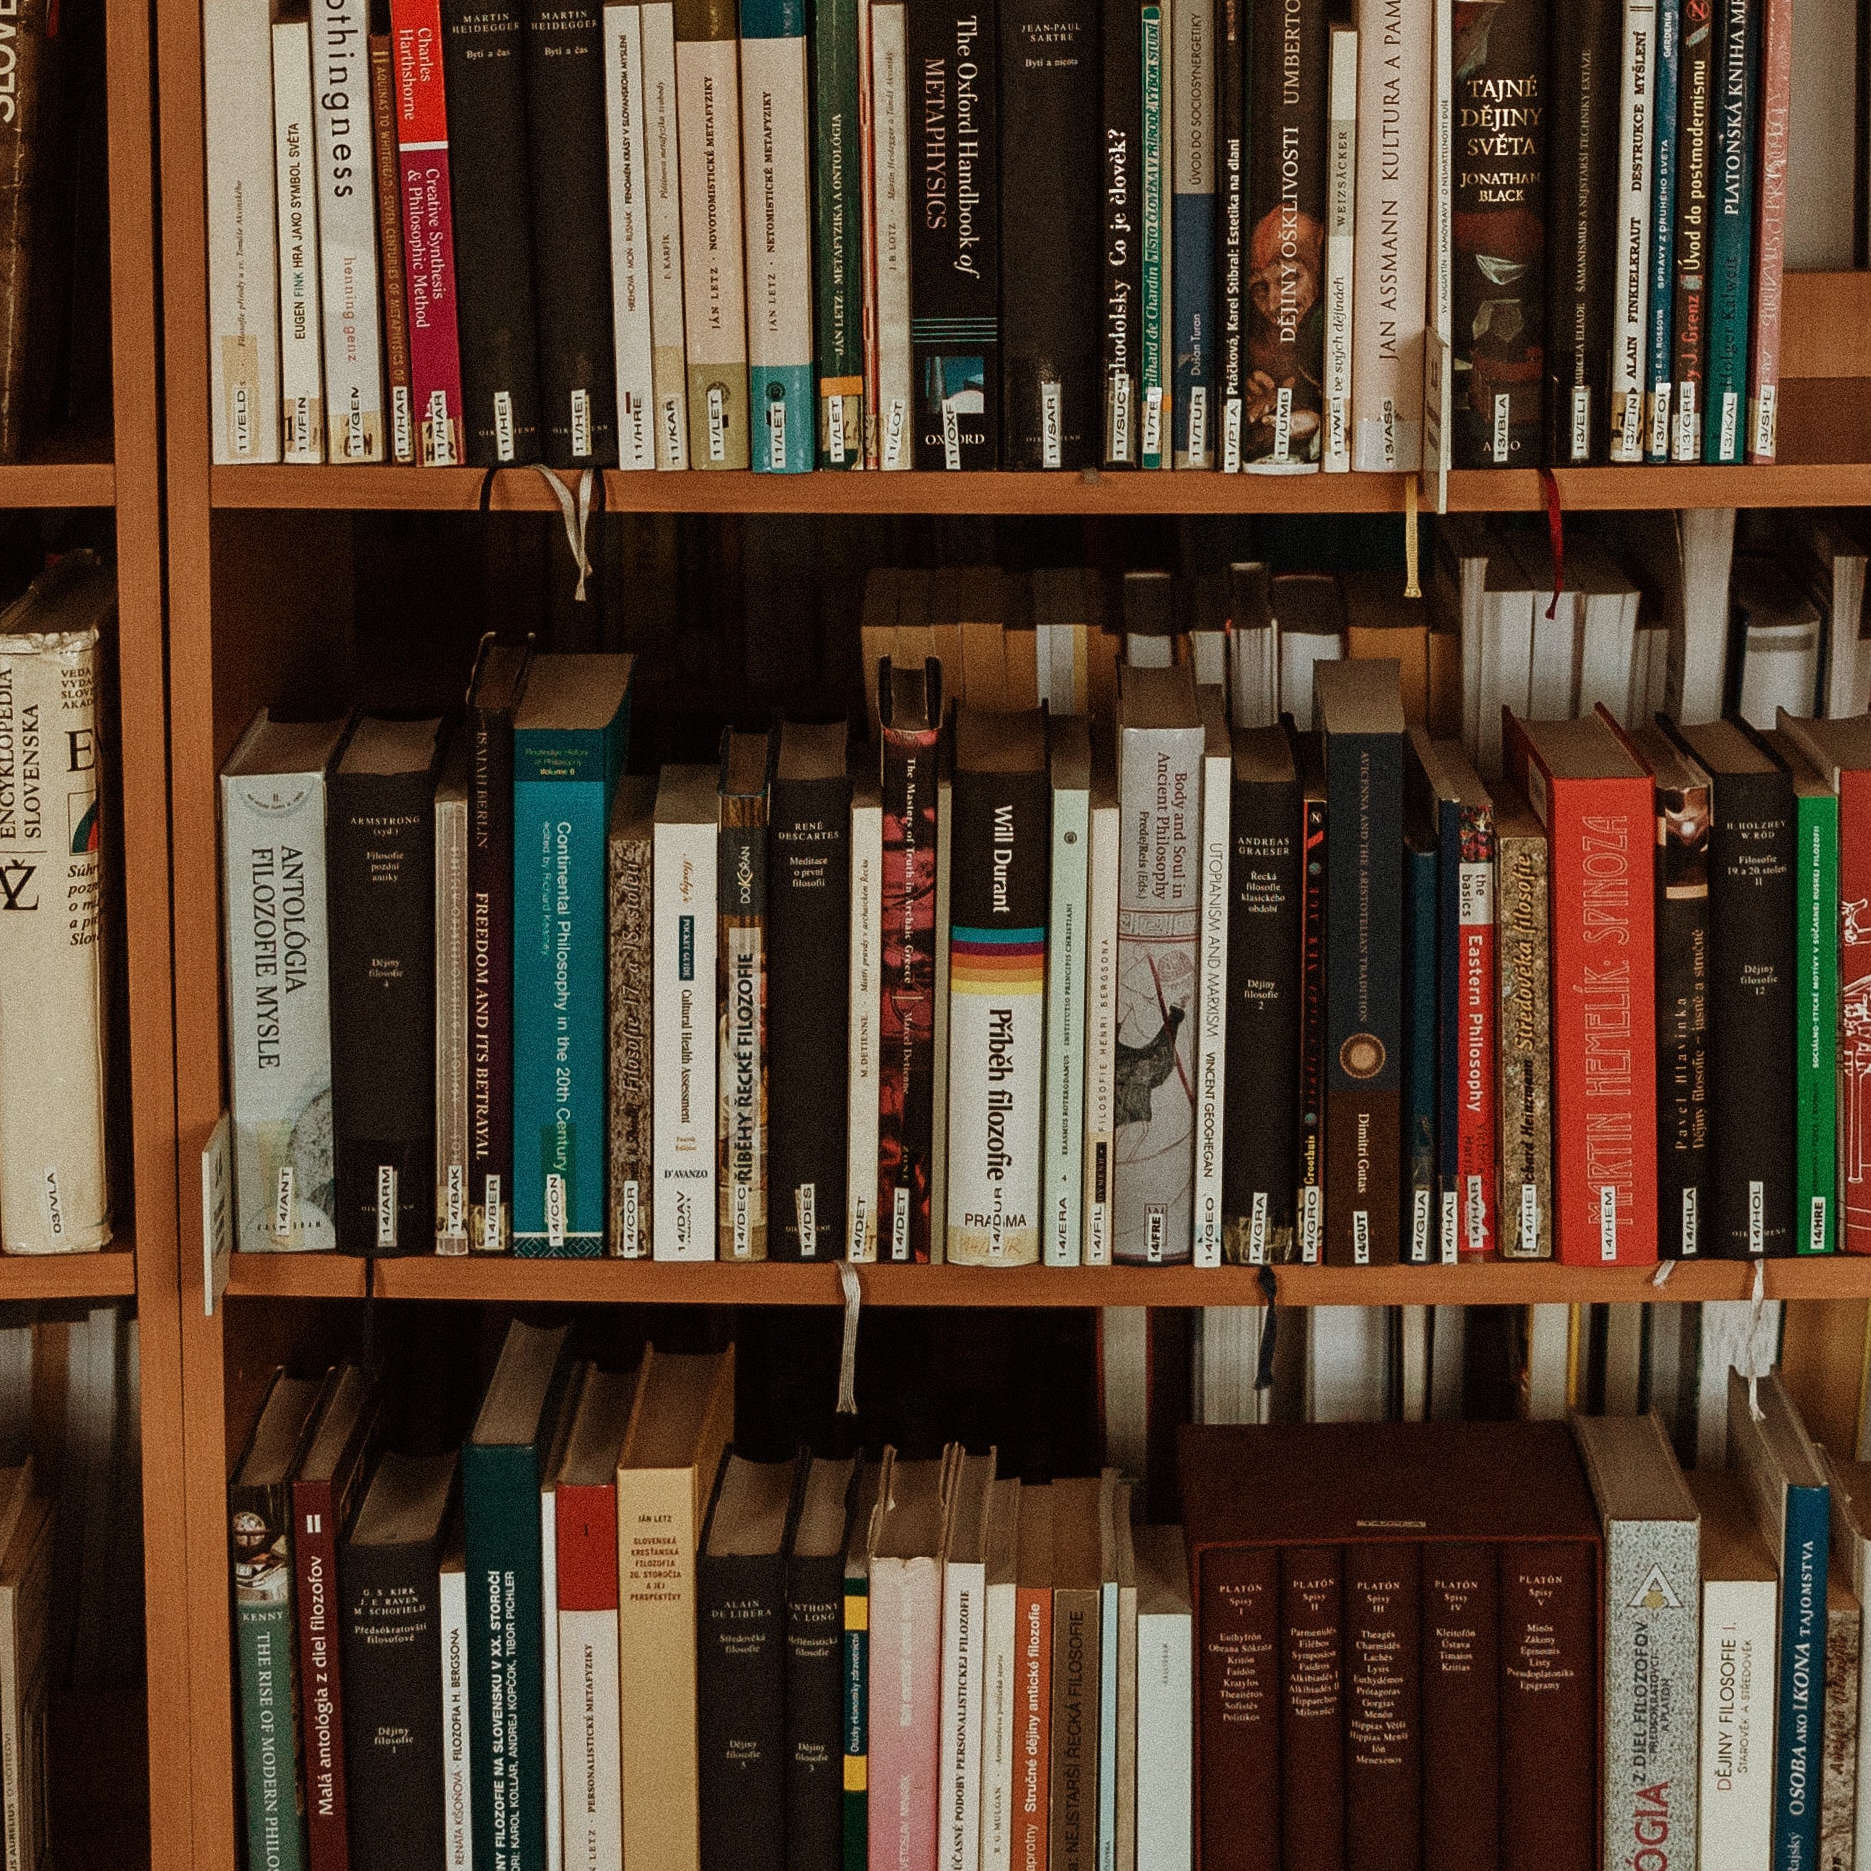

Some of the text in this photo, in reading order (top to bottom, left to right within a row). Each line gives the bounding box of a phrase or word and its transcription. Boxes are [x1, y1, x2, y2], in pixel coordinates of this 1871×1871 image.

[463, 13, 510, 24] MARTIN
[1460, 105, 1542, 128] DĚJINY
[1467, 79, 1538, 99] TAJNÉ
[1467, 132, 1537, 156] SVĚTA
[1283, 126, 1296, 257] OŠKLIVOSTI
[1279, 261, 1298, 342] DĚJINY
[992, 804, 1014, 912] Will Durant
[1460, 873, 1472, 918] basics
[1474, 871, 1486, 897] the
[252, 847, 280, 1069] FILOZOFIE MYSLE
[282, 845, 307, 994] ANTOLÓGIA
[556, 821, 571, 1015] Continental Philosophy
[1468, 936, 1482, 1112] Eastern Philosophy
[986, 1009, 1011, 1180] Příběh filozofie
[664, 1170, 708, 1178] D'AVANZO
[242, 1610, 284, 1619] KENNY
[310, 1555, 332, 1817] Malá antológia z diel filozofov
